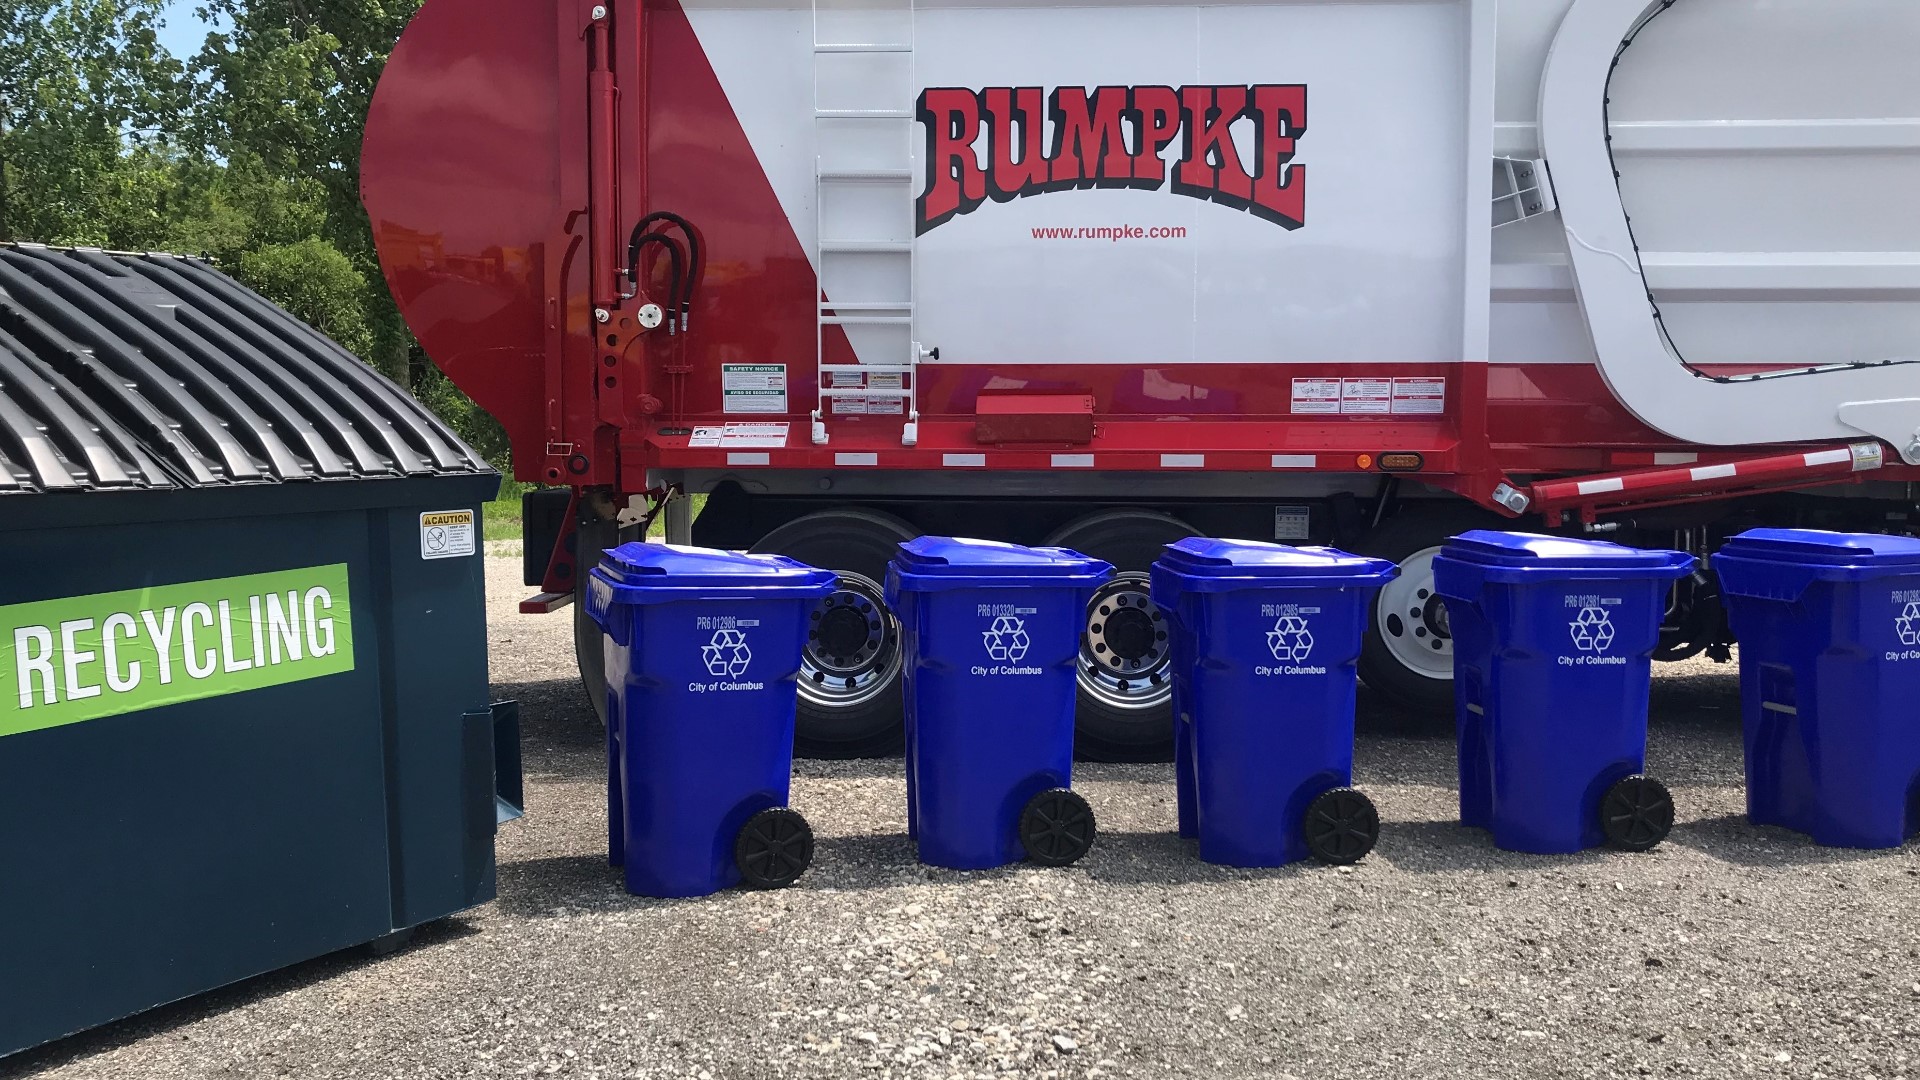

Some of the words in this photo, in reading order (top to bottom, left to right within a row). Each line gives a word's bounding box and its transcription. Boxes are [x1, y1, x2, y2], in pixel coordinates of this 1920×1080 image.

[916, 84, 1307, 238] RUMPKE
[1031, 224, 1187, 242] www.rumpke.com
[431, 514, 470, 525] CAUTION
[1564, 595, 1578, 608] PR6
[1578, 595, 1600, 608] 012981
[977, 604, 991, 617] PR6
[992, 604, 1015, 617] 013320
[1261, 604, 1275, 617] PR6
[1275, 604, 1298, 617] 012985
[696, 616, 711, 630] PR6
[712, 616, 736, 630] 012986
[13, 585, 336, 710] RECYCLING
[1557, 656, 1574, 666] City
[1575, 656, 1585, 664] of
[1586, 655, 1627, 665] Columbus
[1885, 652, 1899, 661] City
[1900, 651, 1908, 659] of
[970, 666, 988, 677] City
[989, 666, 999, 675] of
[1000, 666, 1043, 675] Columbus
[1255, 666, 1272, 677] City
[1273, 665, 1283, 675] of
[1284, 665, 1326, 675] Columbus
[688, 682, 706, 693] City
[708, 682, 719, 691] of
[719, 681, 764, 691] Columbus
